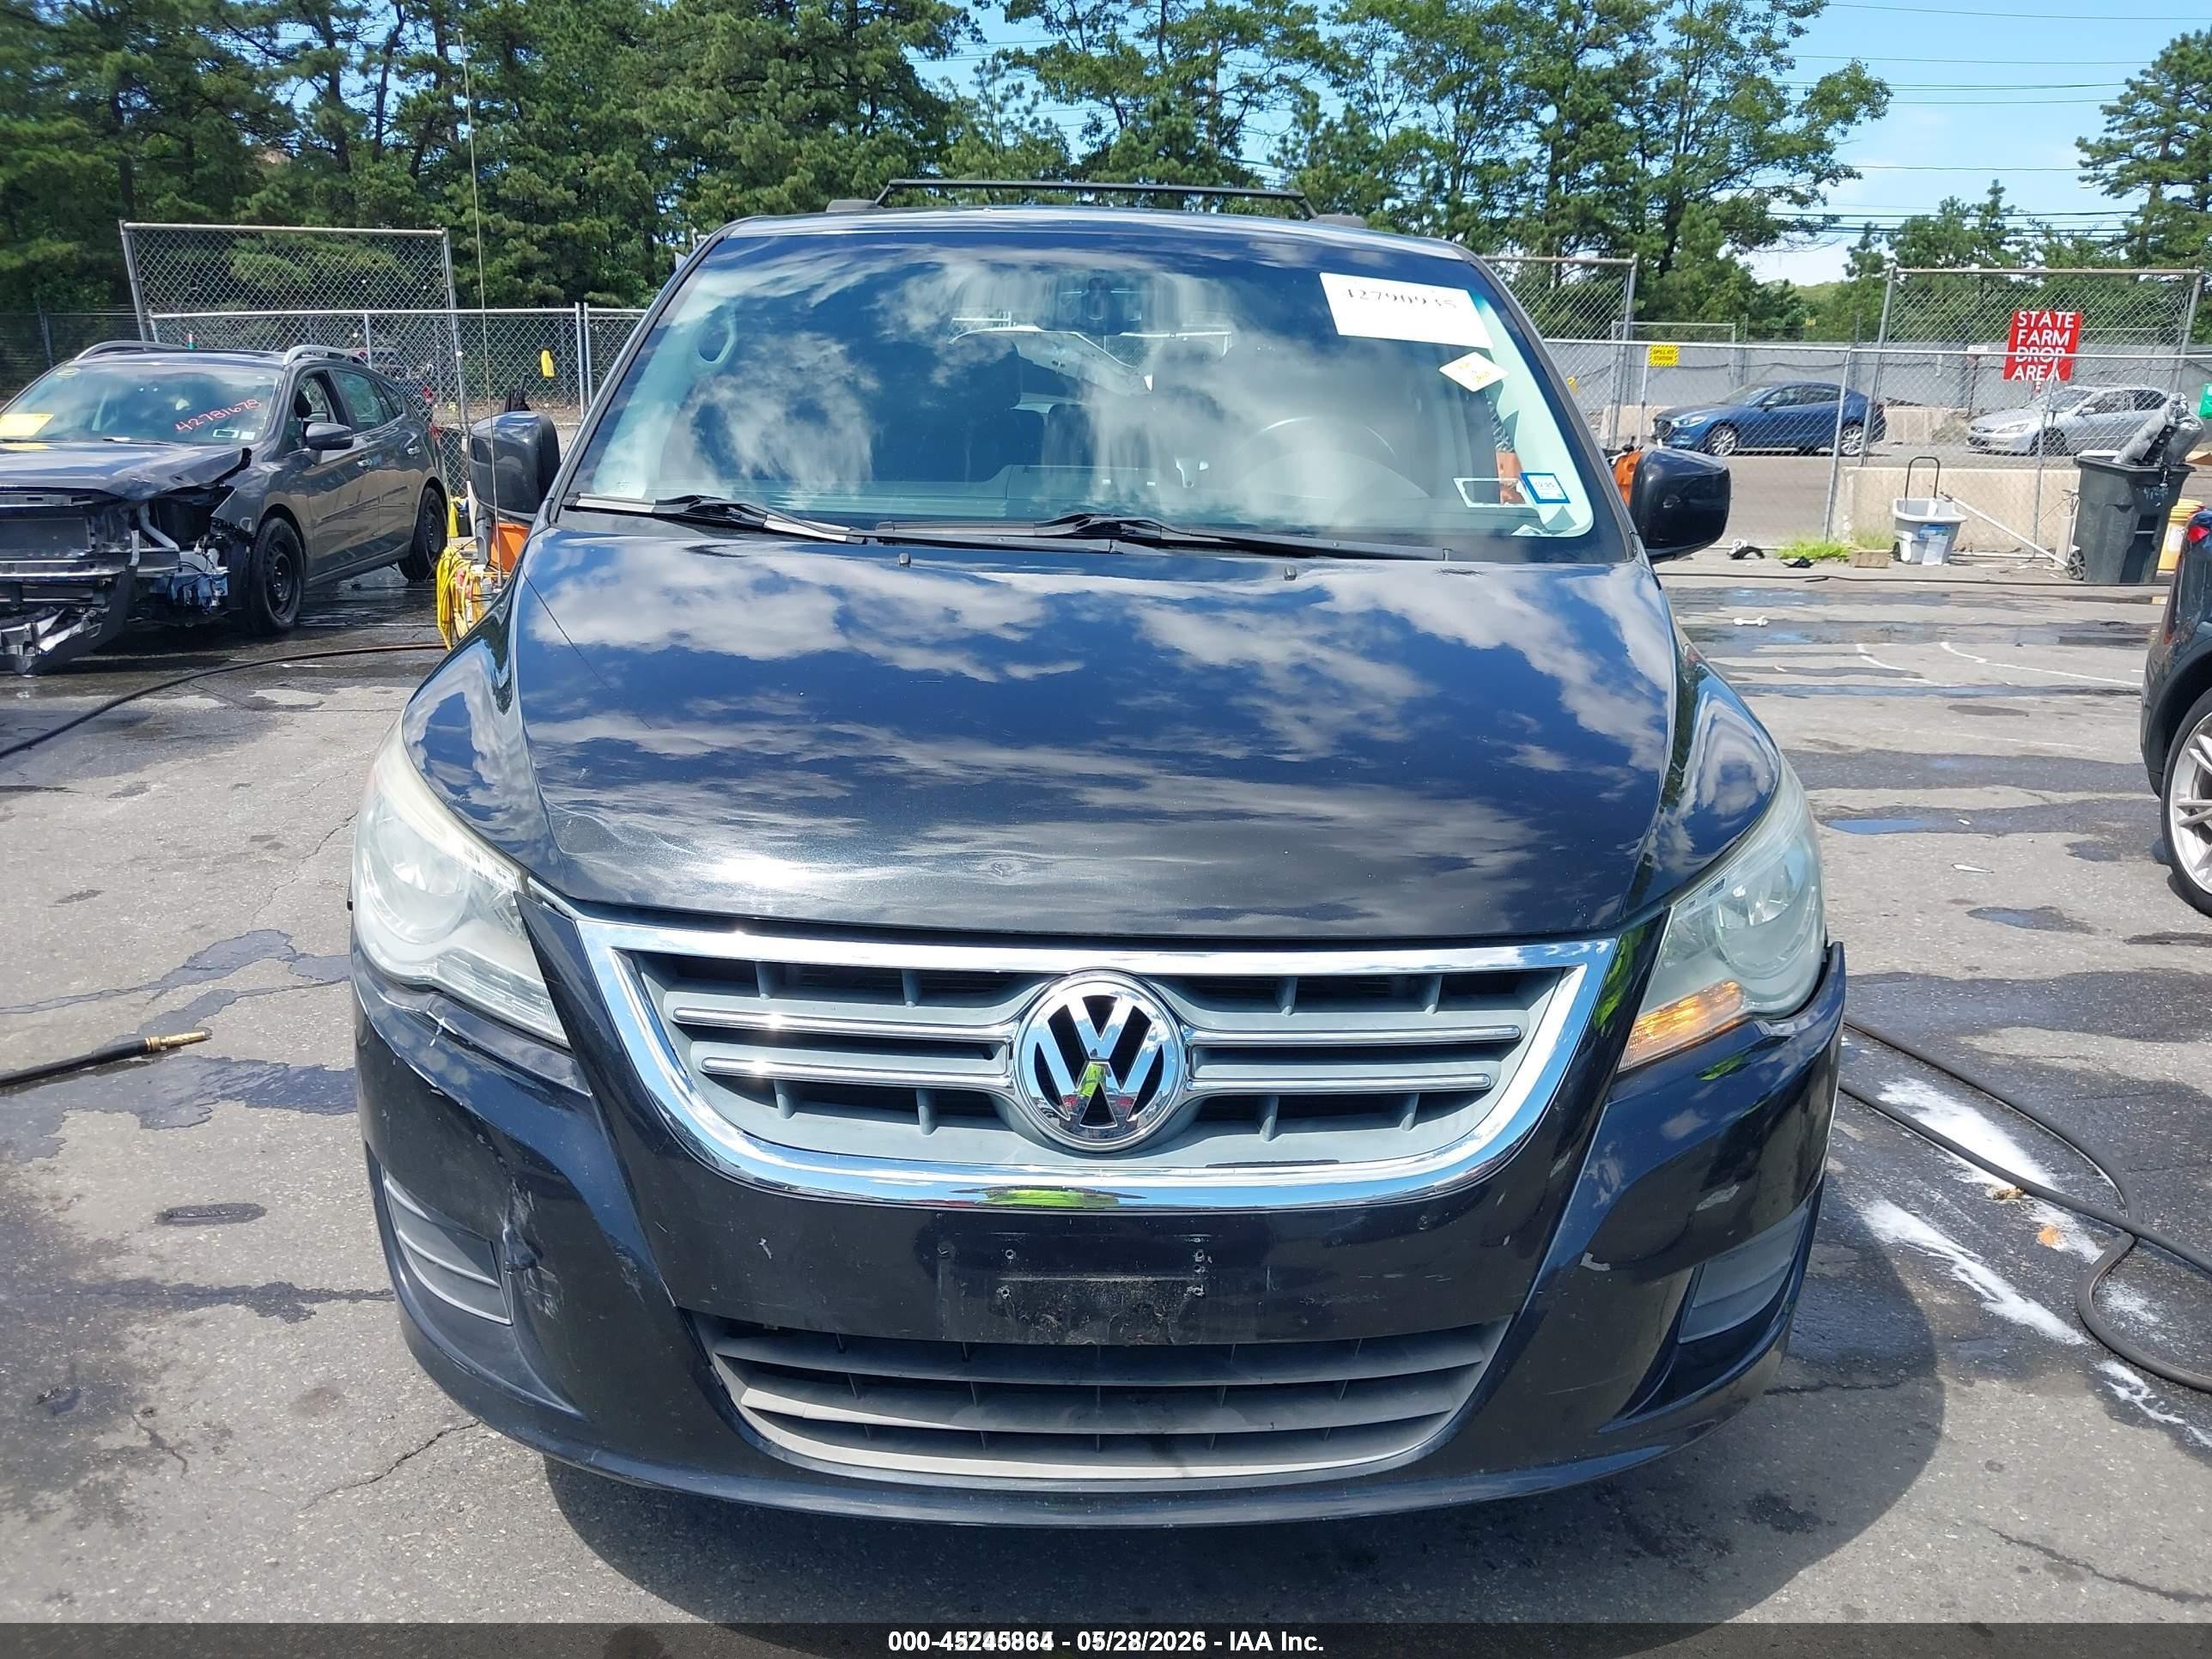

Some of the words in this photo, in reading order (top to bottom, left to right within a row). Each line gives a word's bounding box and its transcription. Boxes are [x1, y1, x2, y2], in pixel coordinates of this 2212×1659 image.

[2016, 310, 2076, 328] STATE
[2016, 328, 2071, 346] FARM
[2014, 345, 2066, 363] DROP
[2010, 364, 2061, 381] AREA
[174, 398, 262, 431] 42781678
[1026, 983, 1170, 1129] VW
